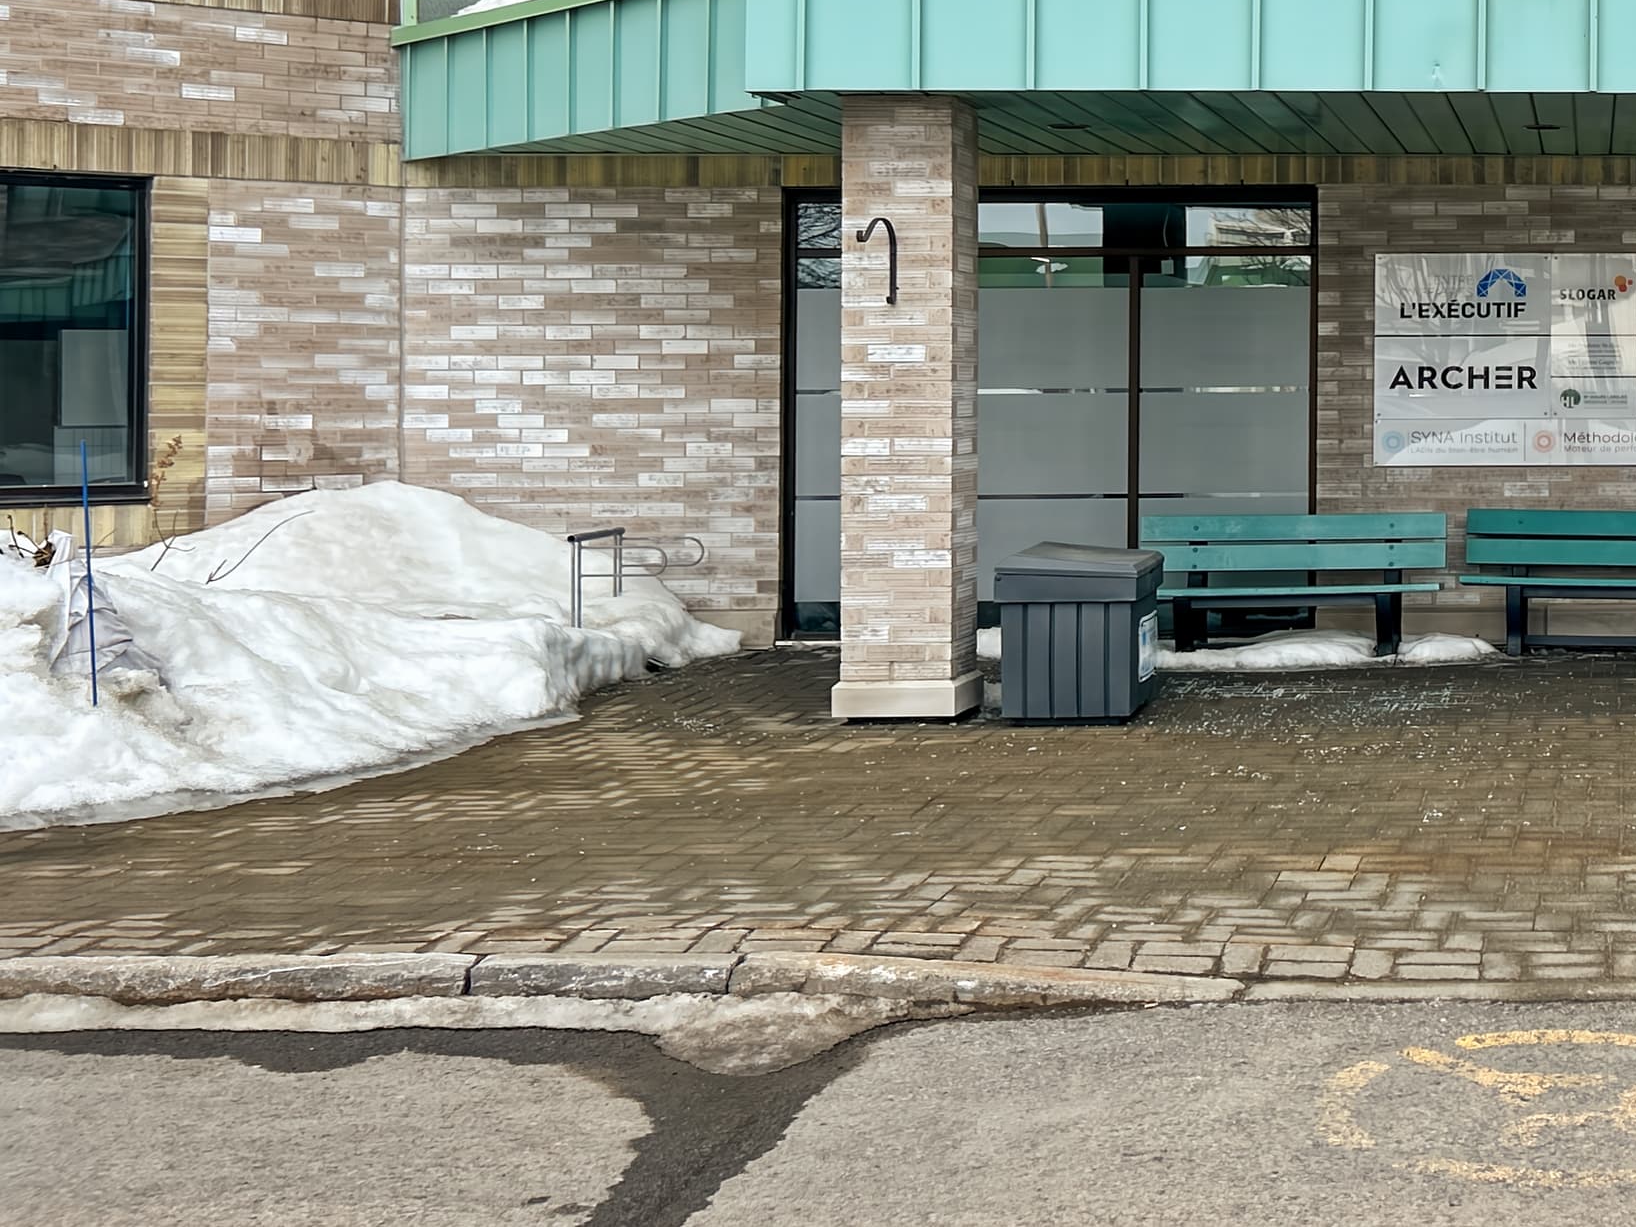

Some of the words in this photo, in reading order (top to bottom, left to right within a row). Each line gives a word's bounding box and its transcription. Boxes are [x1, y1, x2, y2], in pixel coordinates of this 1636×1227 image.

[1560, 289, 1617, 300] SLOGAR
[1400, 299, 1527, 319] L'EXÉCUTIF
[1389, 365, 1538, 390] ARCHER
[1411, 431, 1454, 444] SYNA
[1460, 431, 1518, 444] Institut
